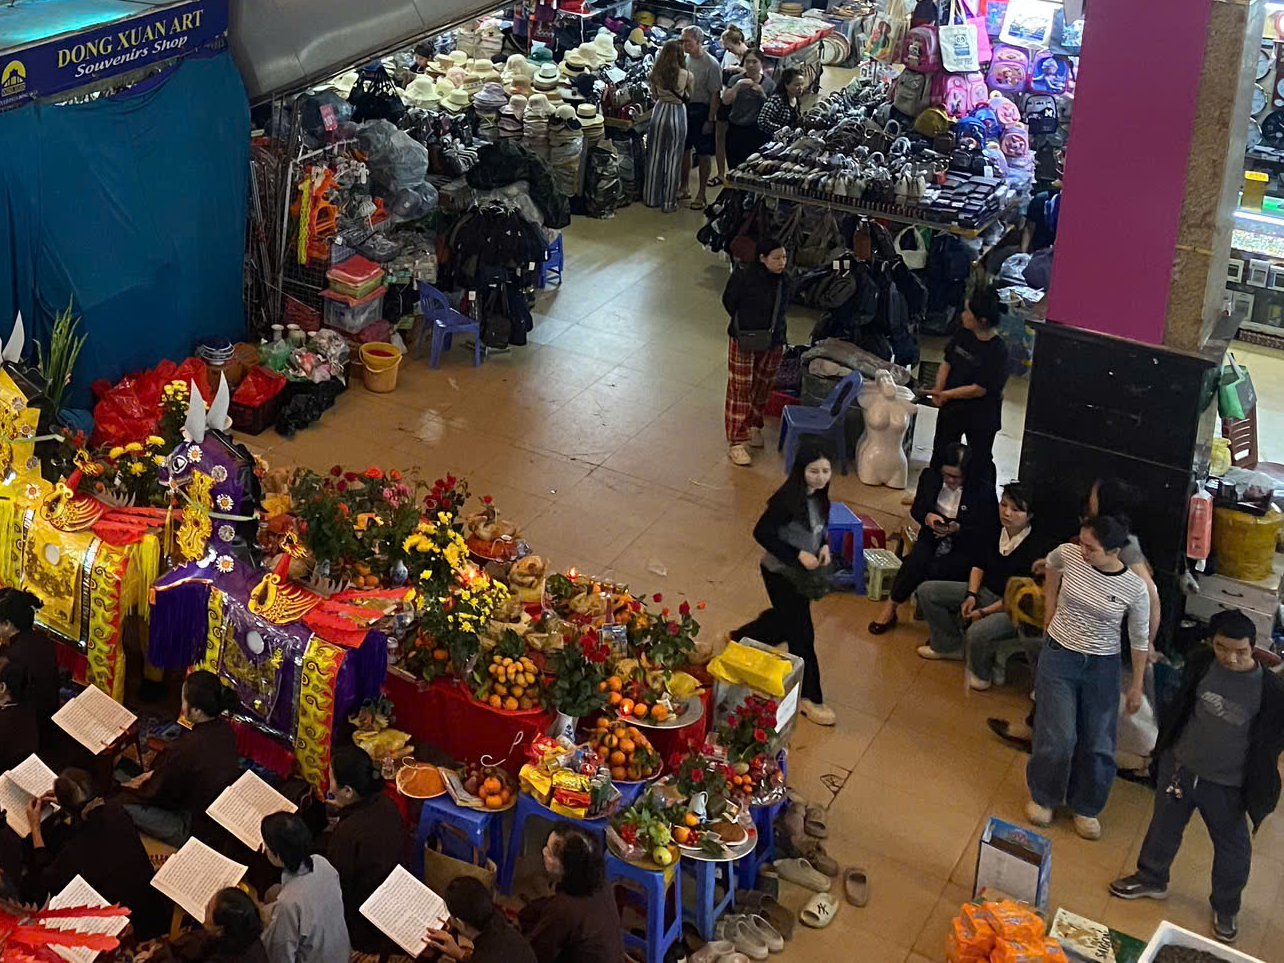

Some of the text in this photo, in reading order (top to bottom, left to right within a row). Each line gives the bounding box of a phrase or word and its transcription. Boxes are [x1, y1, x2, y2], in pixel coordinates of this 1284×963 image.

[57, 9, 204, 69] DONG XUAN ART
[74, 33, 188, 78] Souvenirs Shop
